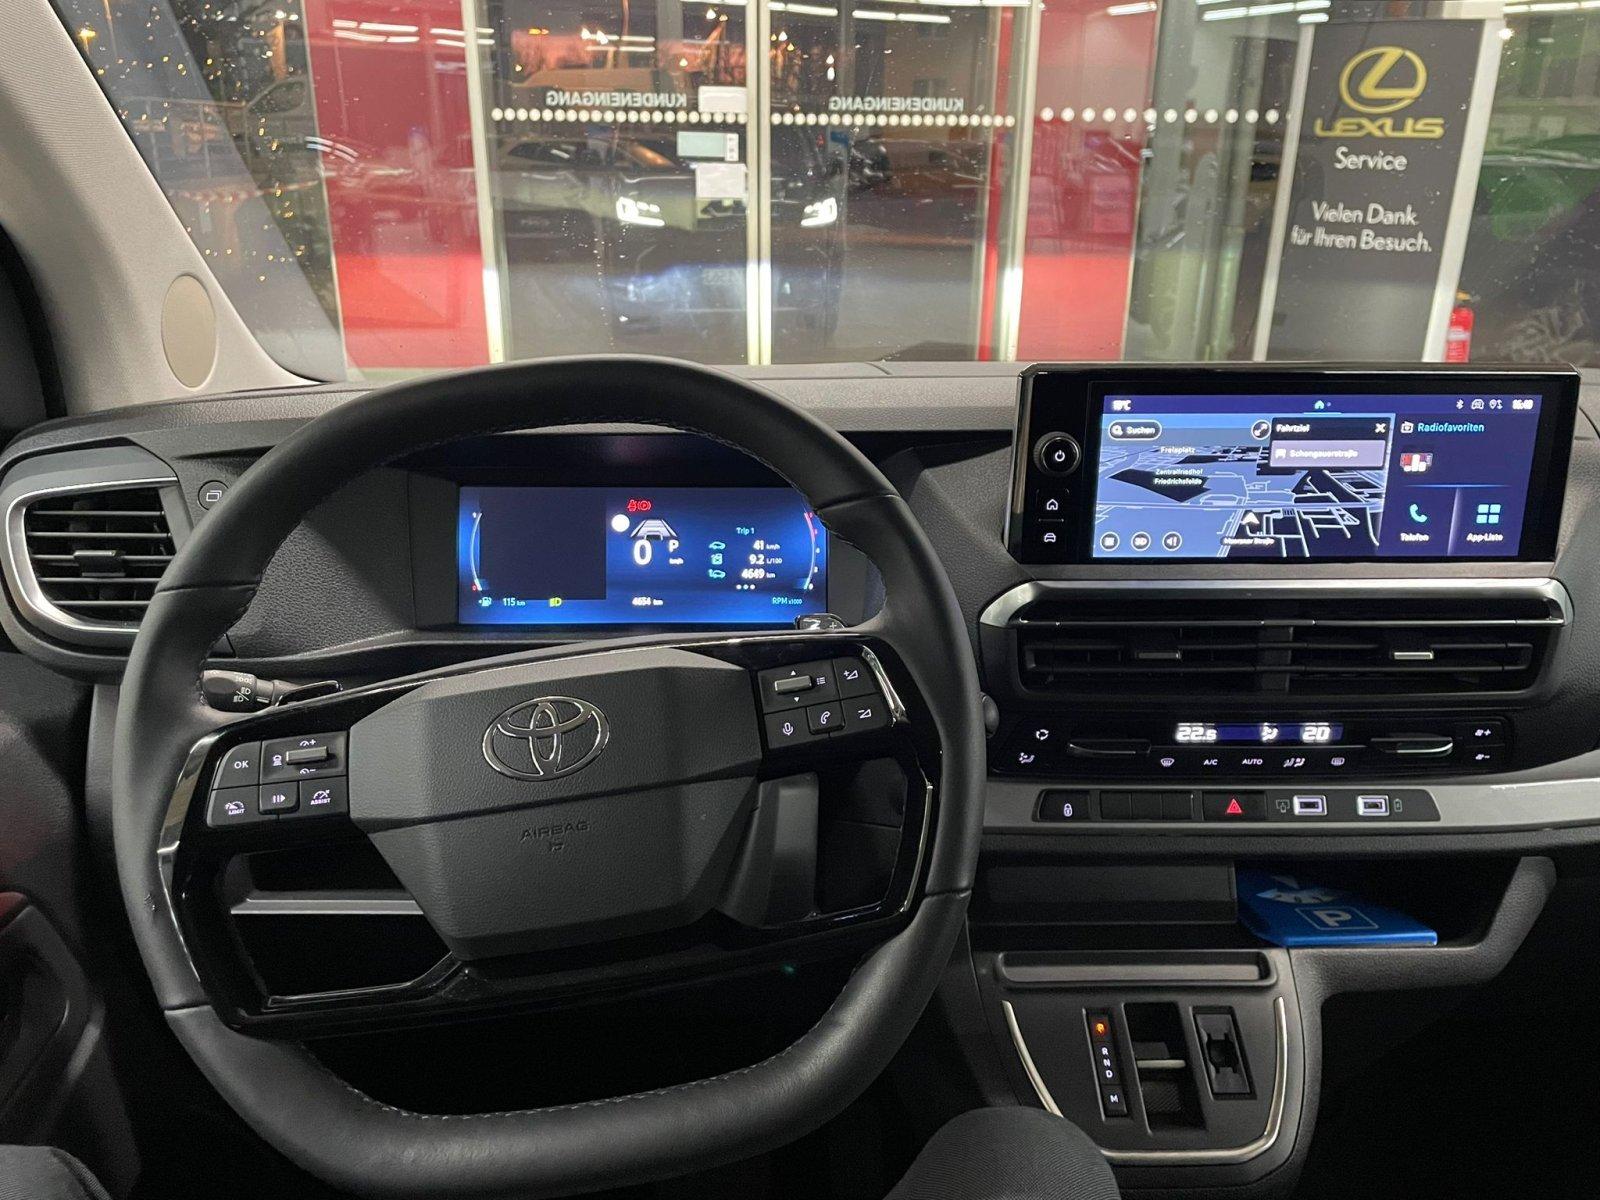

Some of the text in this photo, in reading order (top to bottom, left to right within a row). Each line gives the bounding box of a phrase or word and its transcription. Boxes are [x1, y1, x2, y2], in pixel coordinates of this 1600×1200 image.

[1313, 117, 1445, 139] LEXUS
[1333, 146, 1408, 171] Service
[1312, 200, 1364, 224] Vielen
[1290, 224, 1313, 246] für
[1313, 226, 1357, 249] Ihren
[1126, 426, 1156, 435] Suchen
[1276, 423, 1311, 433] Fahrtziel
[1417, 422, 1485, 433] Radiofavoriten
[633, 539, 652, 565] 0
[749, 554, 765, 564] 9.2
[1302, 725, 1331, 742] 20
[234, 760, 249, 769] OK
[1242, 758, 1263, 766] AUTO
[520, 821, 592, 842] AIRBAG
